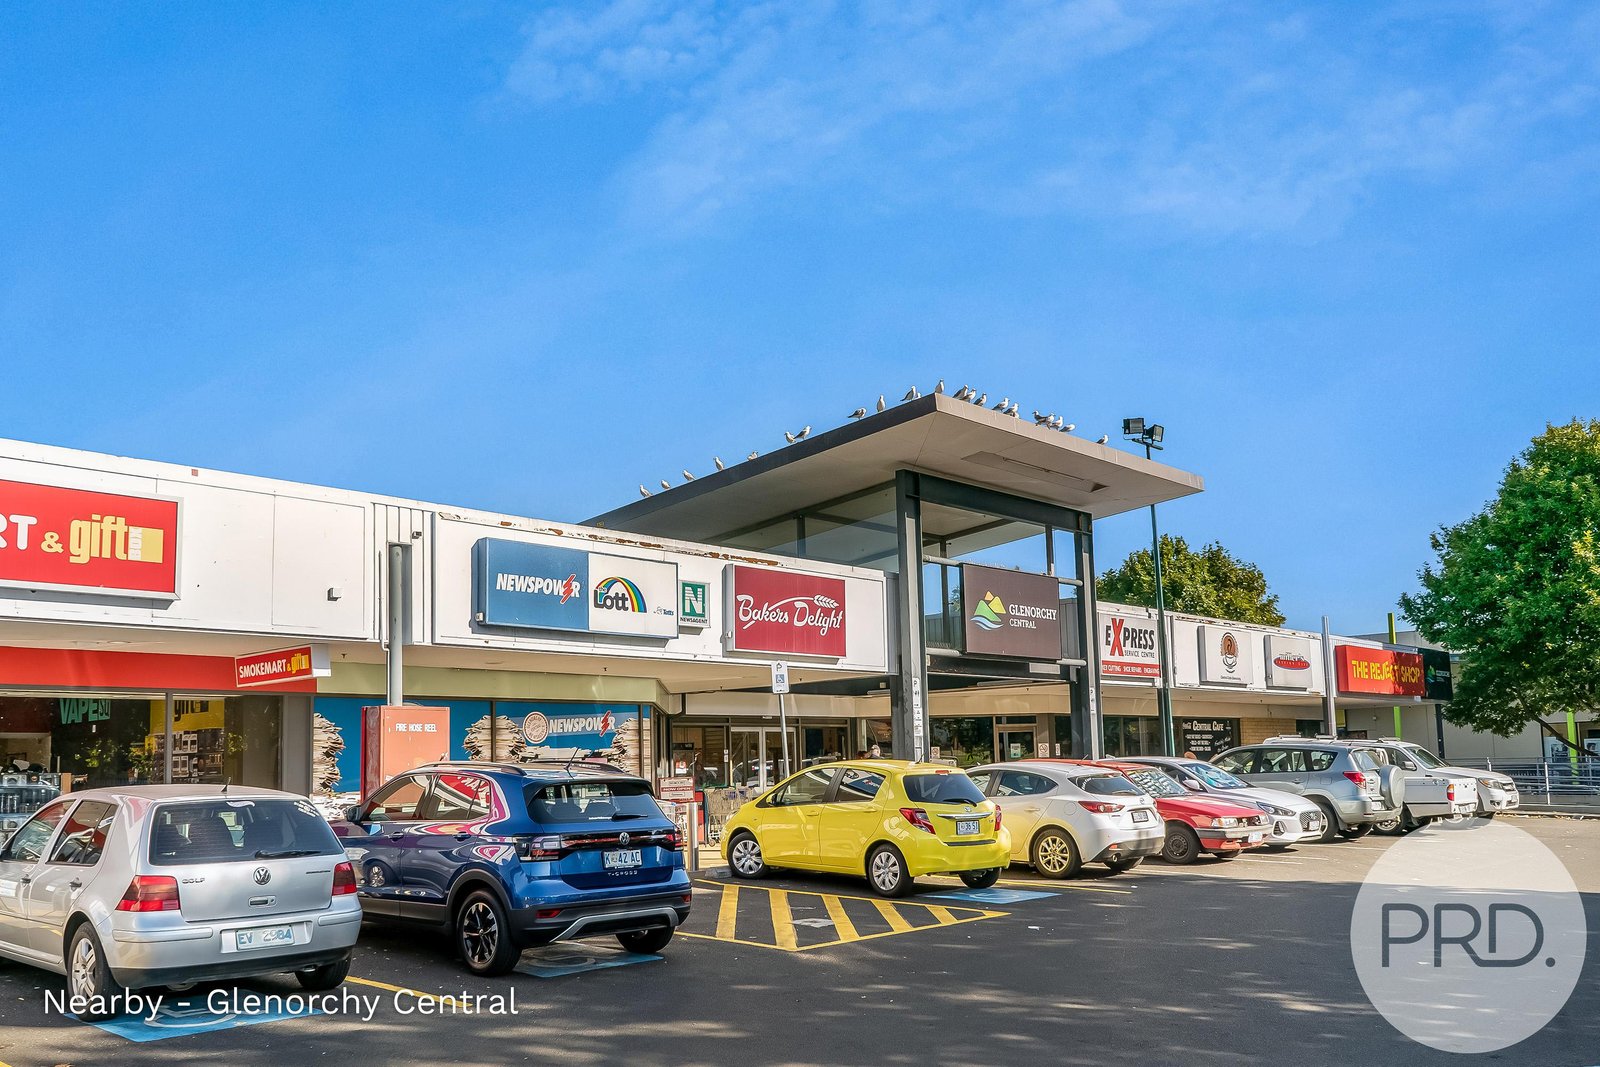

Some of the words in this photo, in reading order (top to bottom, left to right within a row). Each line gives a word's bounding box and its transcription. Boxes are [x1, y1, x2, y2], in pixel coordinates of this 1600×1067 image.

[40, 531, 64, 554] &
[69, 513, 128, 564] gift
[593, 589, 629, 612] Lott
[1009, 604, 1057, 620] GLENORCHY
[736, 594, 789, 624] Bakers
[793, 601, 844, 636] Delight
[1009, 618, 1037, 629] CENTRAL
[1105, 617, 1155, 657] EXPRESS
[239, 659, 287, 678] SMOKEMART
[1351, 660, 1369, 679] THE
[1370, 661, 1400, 682] REJECT
[1401, 665, 1421, 683] SHOP
[59, 698, 98, 724] VAPE
[395, 723, 407, 732] FIRE
[409, 723, 422, 732] HOSE
[424, 723, 437, 733] REEL
